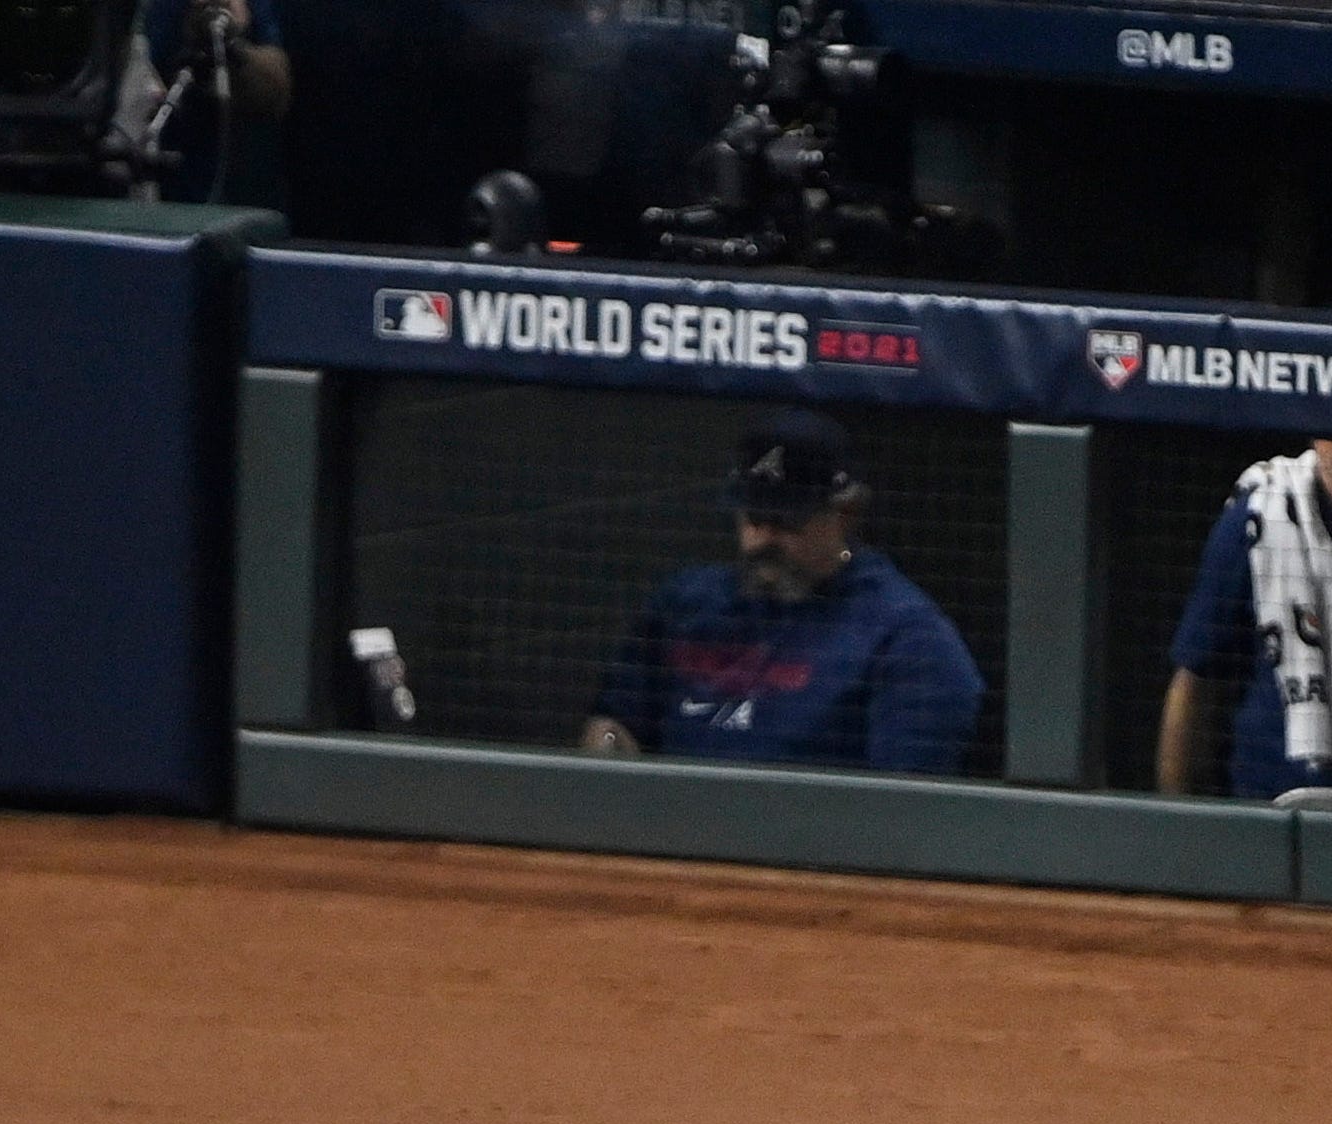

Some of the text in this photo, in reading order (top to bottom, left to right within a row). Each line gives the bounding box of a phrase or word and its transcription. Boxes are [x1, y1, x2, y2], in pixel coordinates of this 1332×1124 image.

[1117, 29, 1233, 72] @MLB
[459, 290, 920, 369] WORLD SERIES 2021
